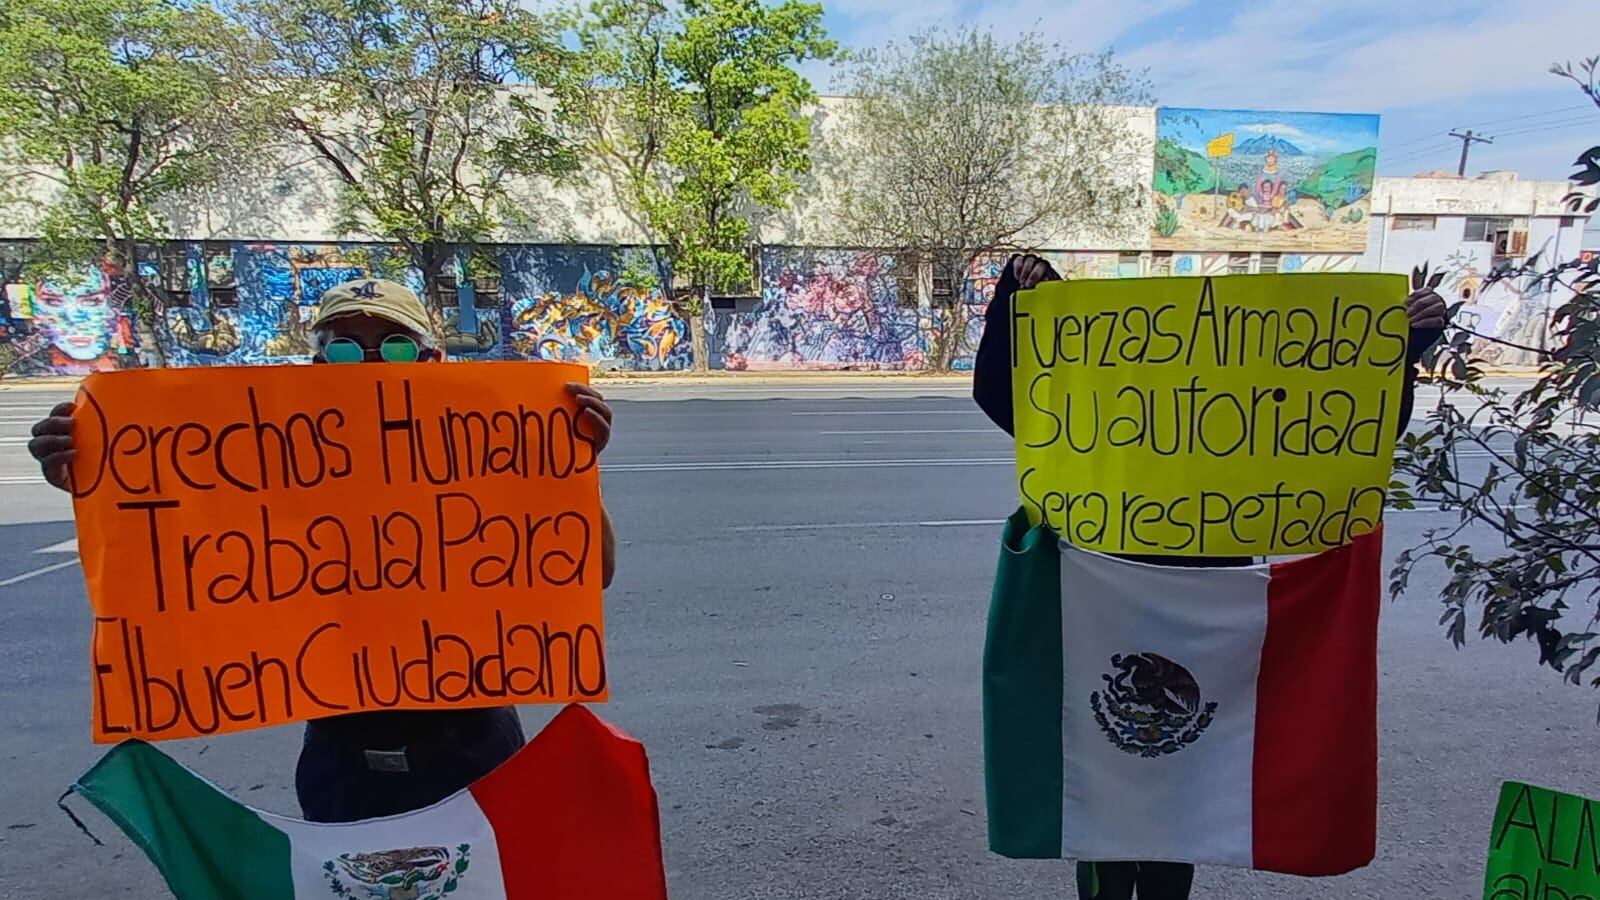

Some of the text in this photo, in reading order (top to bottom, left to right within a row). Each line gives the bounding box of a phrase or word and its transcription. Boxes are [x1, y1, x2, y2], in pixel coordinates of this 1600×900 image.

[1012, 291, 1183, 368] Fuerzas
[67, 380, 597, 499] Derechos Humanos
[436, 493, 591, 592] Para
[297, 609, 605, 711] Ciudadano
